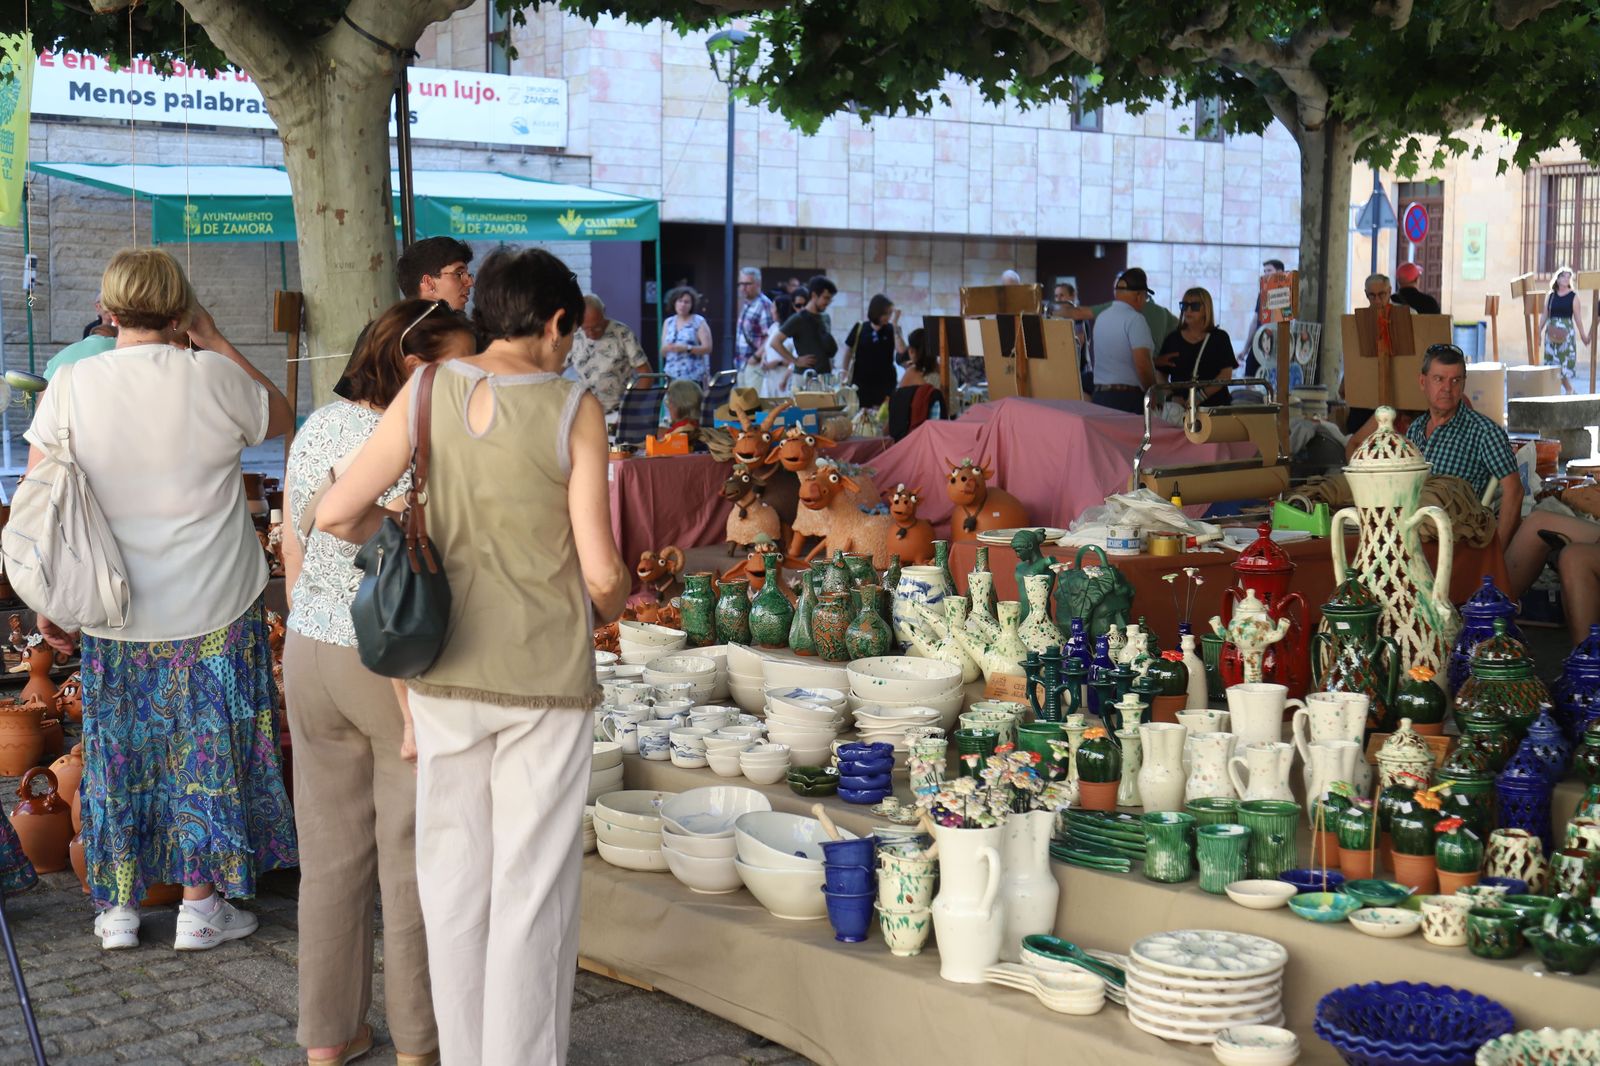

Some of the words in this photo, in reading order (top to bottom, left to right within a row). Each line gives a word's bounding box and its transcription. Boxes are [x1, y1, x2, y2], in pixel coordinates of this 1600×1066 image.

[63, 53, 95, 70] en
[69, 80, 156, 107] Menos
[419, 81, 447, 99] un
[454, 80, 500, 104] lujo.
[202, 212, 273, 221] AYUNTAMIENTO
[466, 213, 528, 222] AYUNTAMIENTO
[203, 223, 219, 234] DE
[223, 222, 274, 234] ZAMORA
[467, 223, 480, 234] DE
[484, 223, 528, 234] ZAMORA
